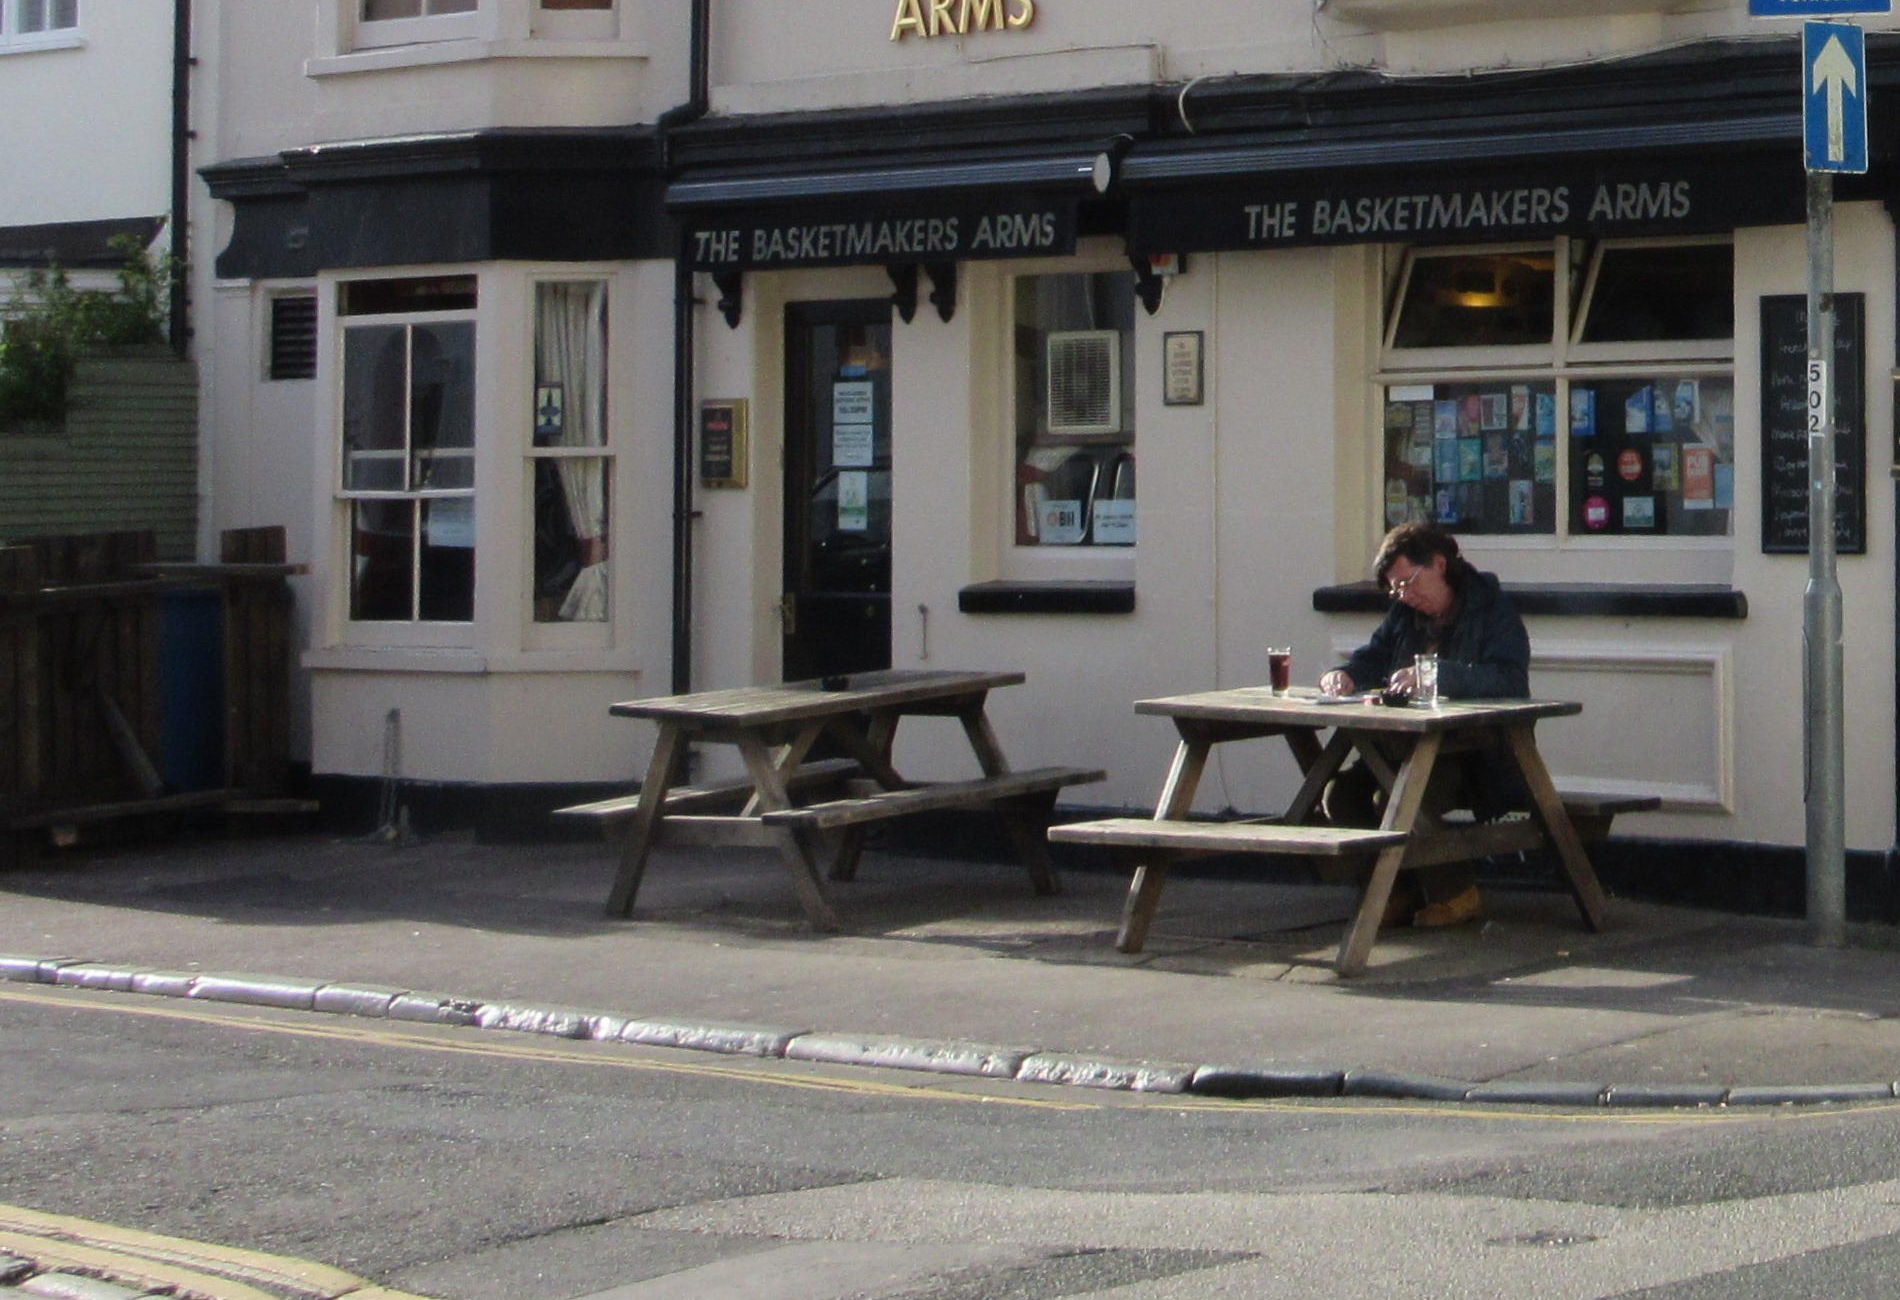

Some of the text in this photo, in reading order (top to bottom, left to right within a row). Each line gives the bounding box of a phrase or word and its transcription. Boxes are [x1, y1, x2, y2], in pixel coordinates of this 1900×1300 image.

[695, 212, 1056, 263] THE BASKETMAKERS ARMS
[1245, 180, 1690, 240] THE BASKETMAKERS ARMS
